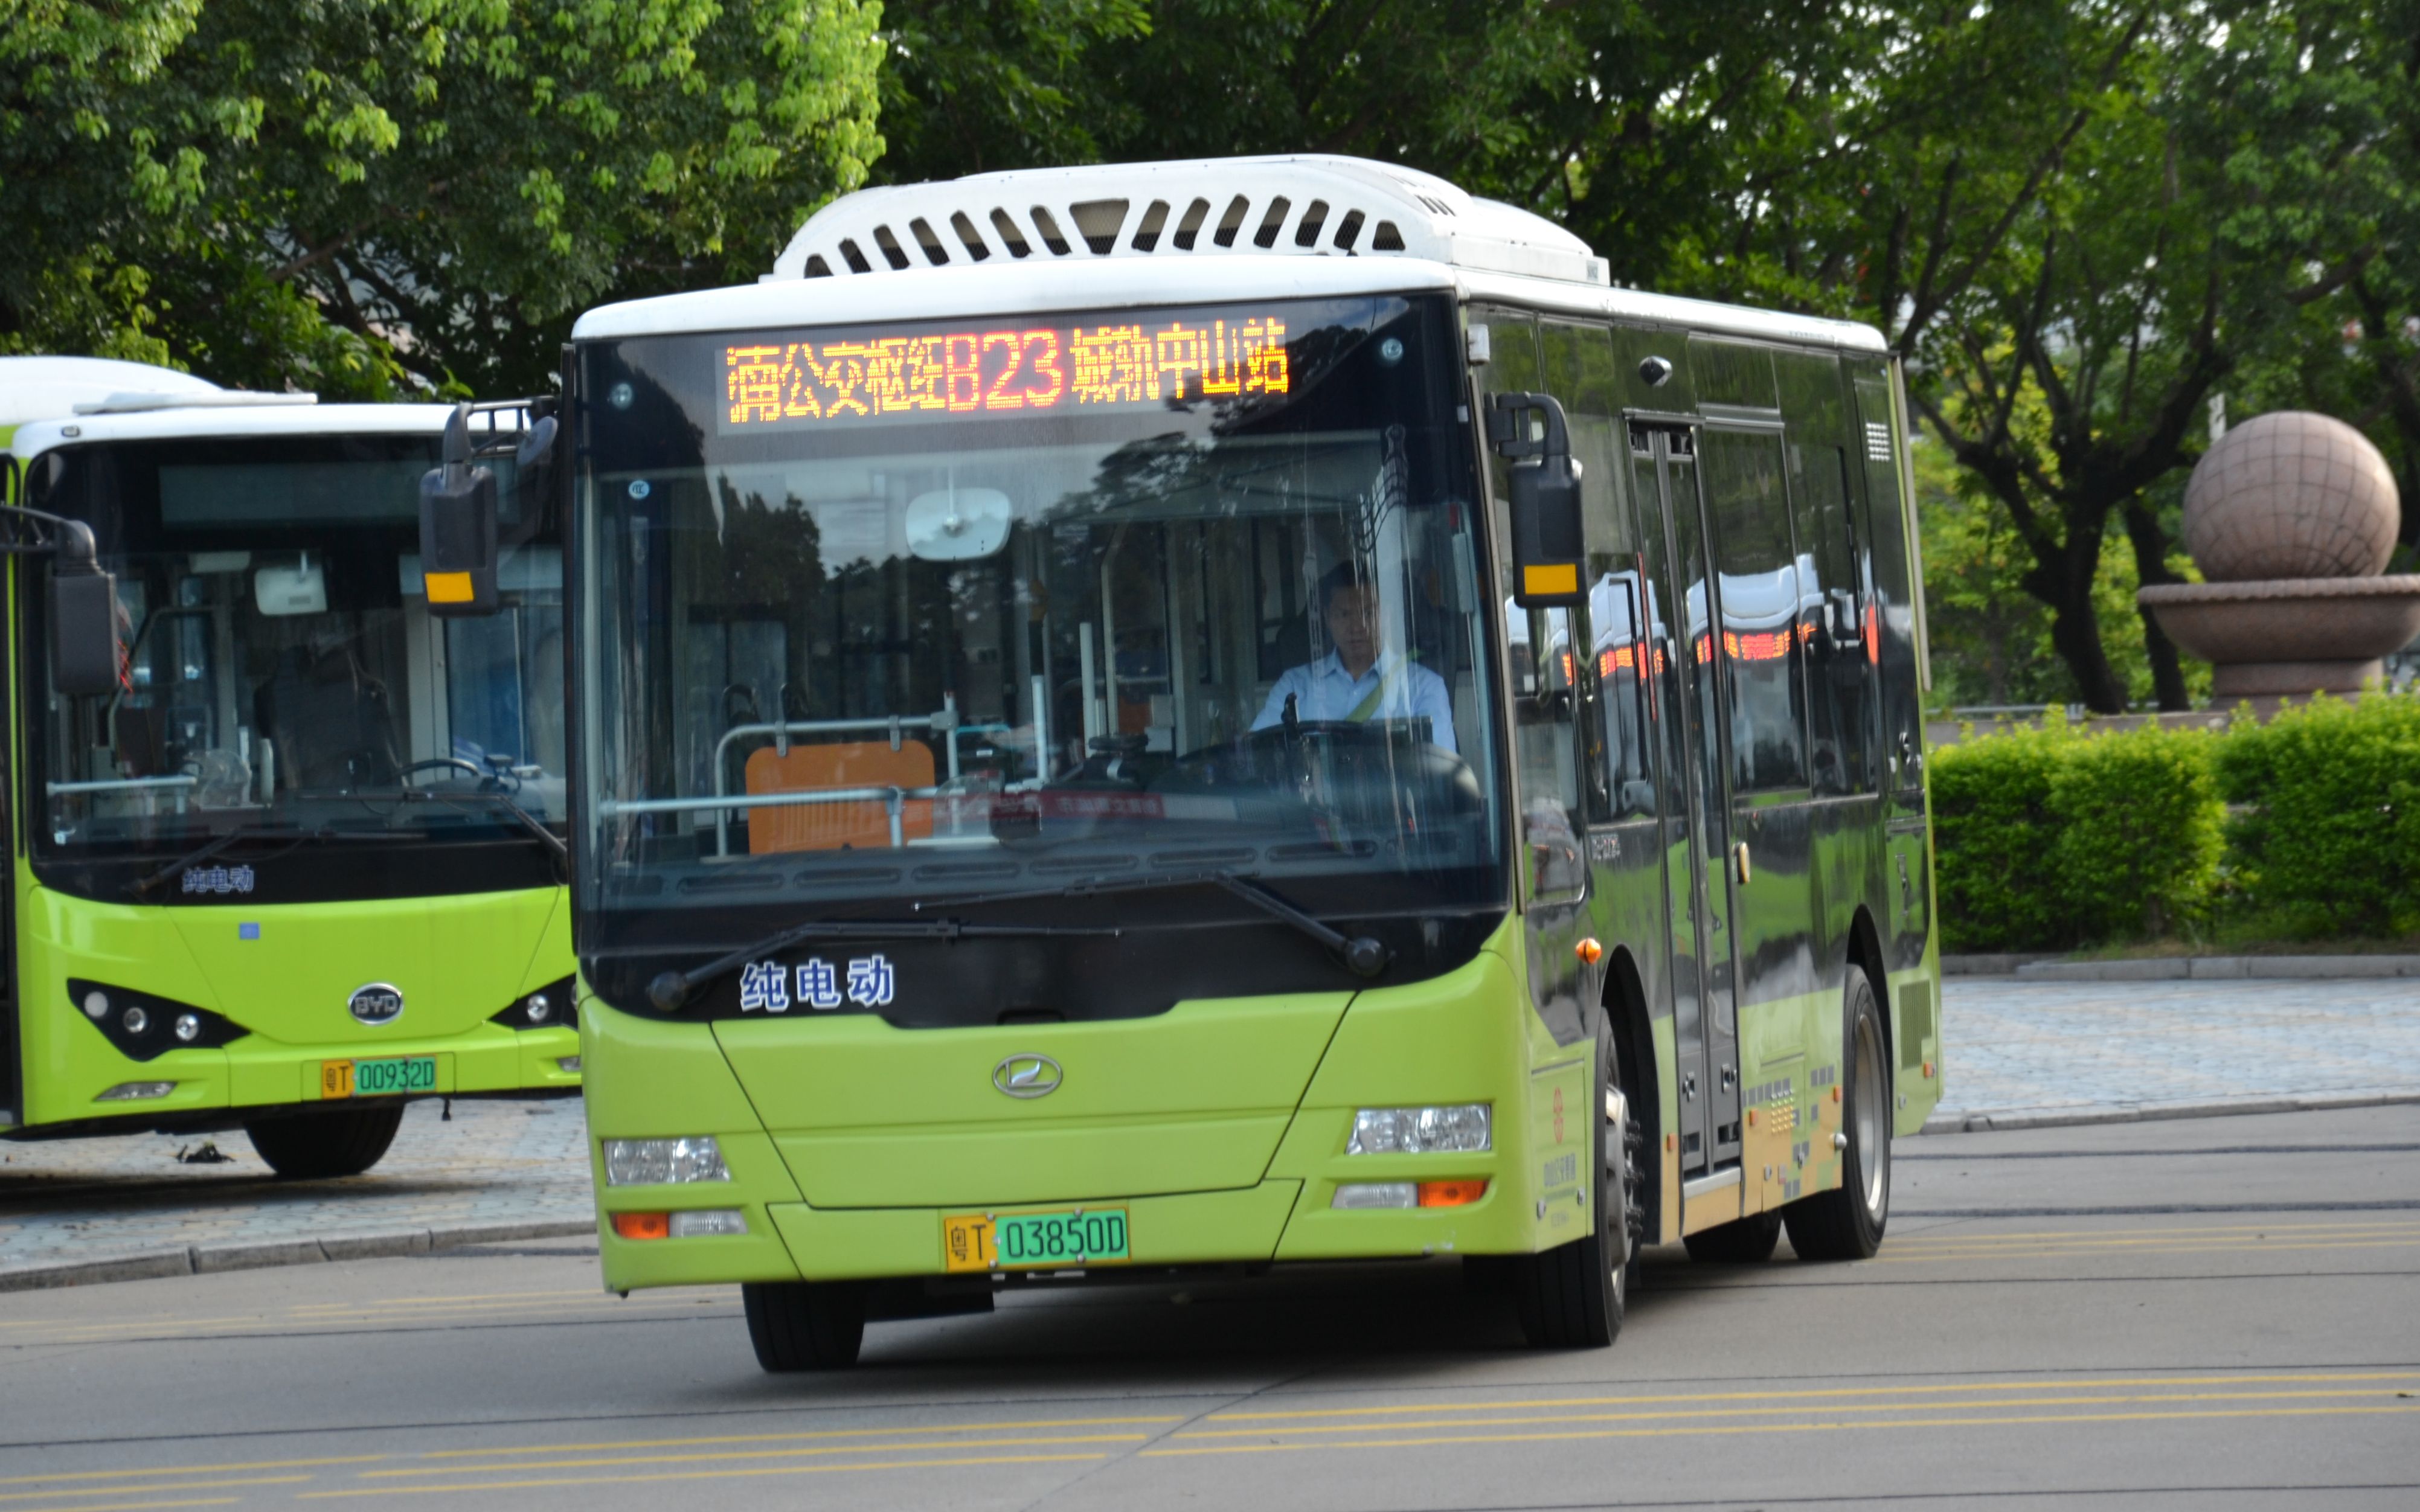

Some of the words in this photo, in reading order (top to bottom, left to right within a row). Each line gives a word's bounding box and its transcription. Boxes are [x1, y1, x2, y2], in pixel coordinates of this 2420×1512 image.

[945, 328, 1063, 412] B23
[1070, 316, 1289, 405] 城轨中山站
[182, 864, 254, 893] 纯电动
[740, 953, 893, 1012] 纯电动
[354, 995, 399, 1014] BYD
[1006, 1216, 1125, 1258] 03850D
